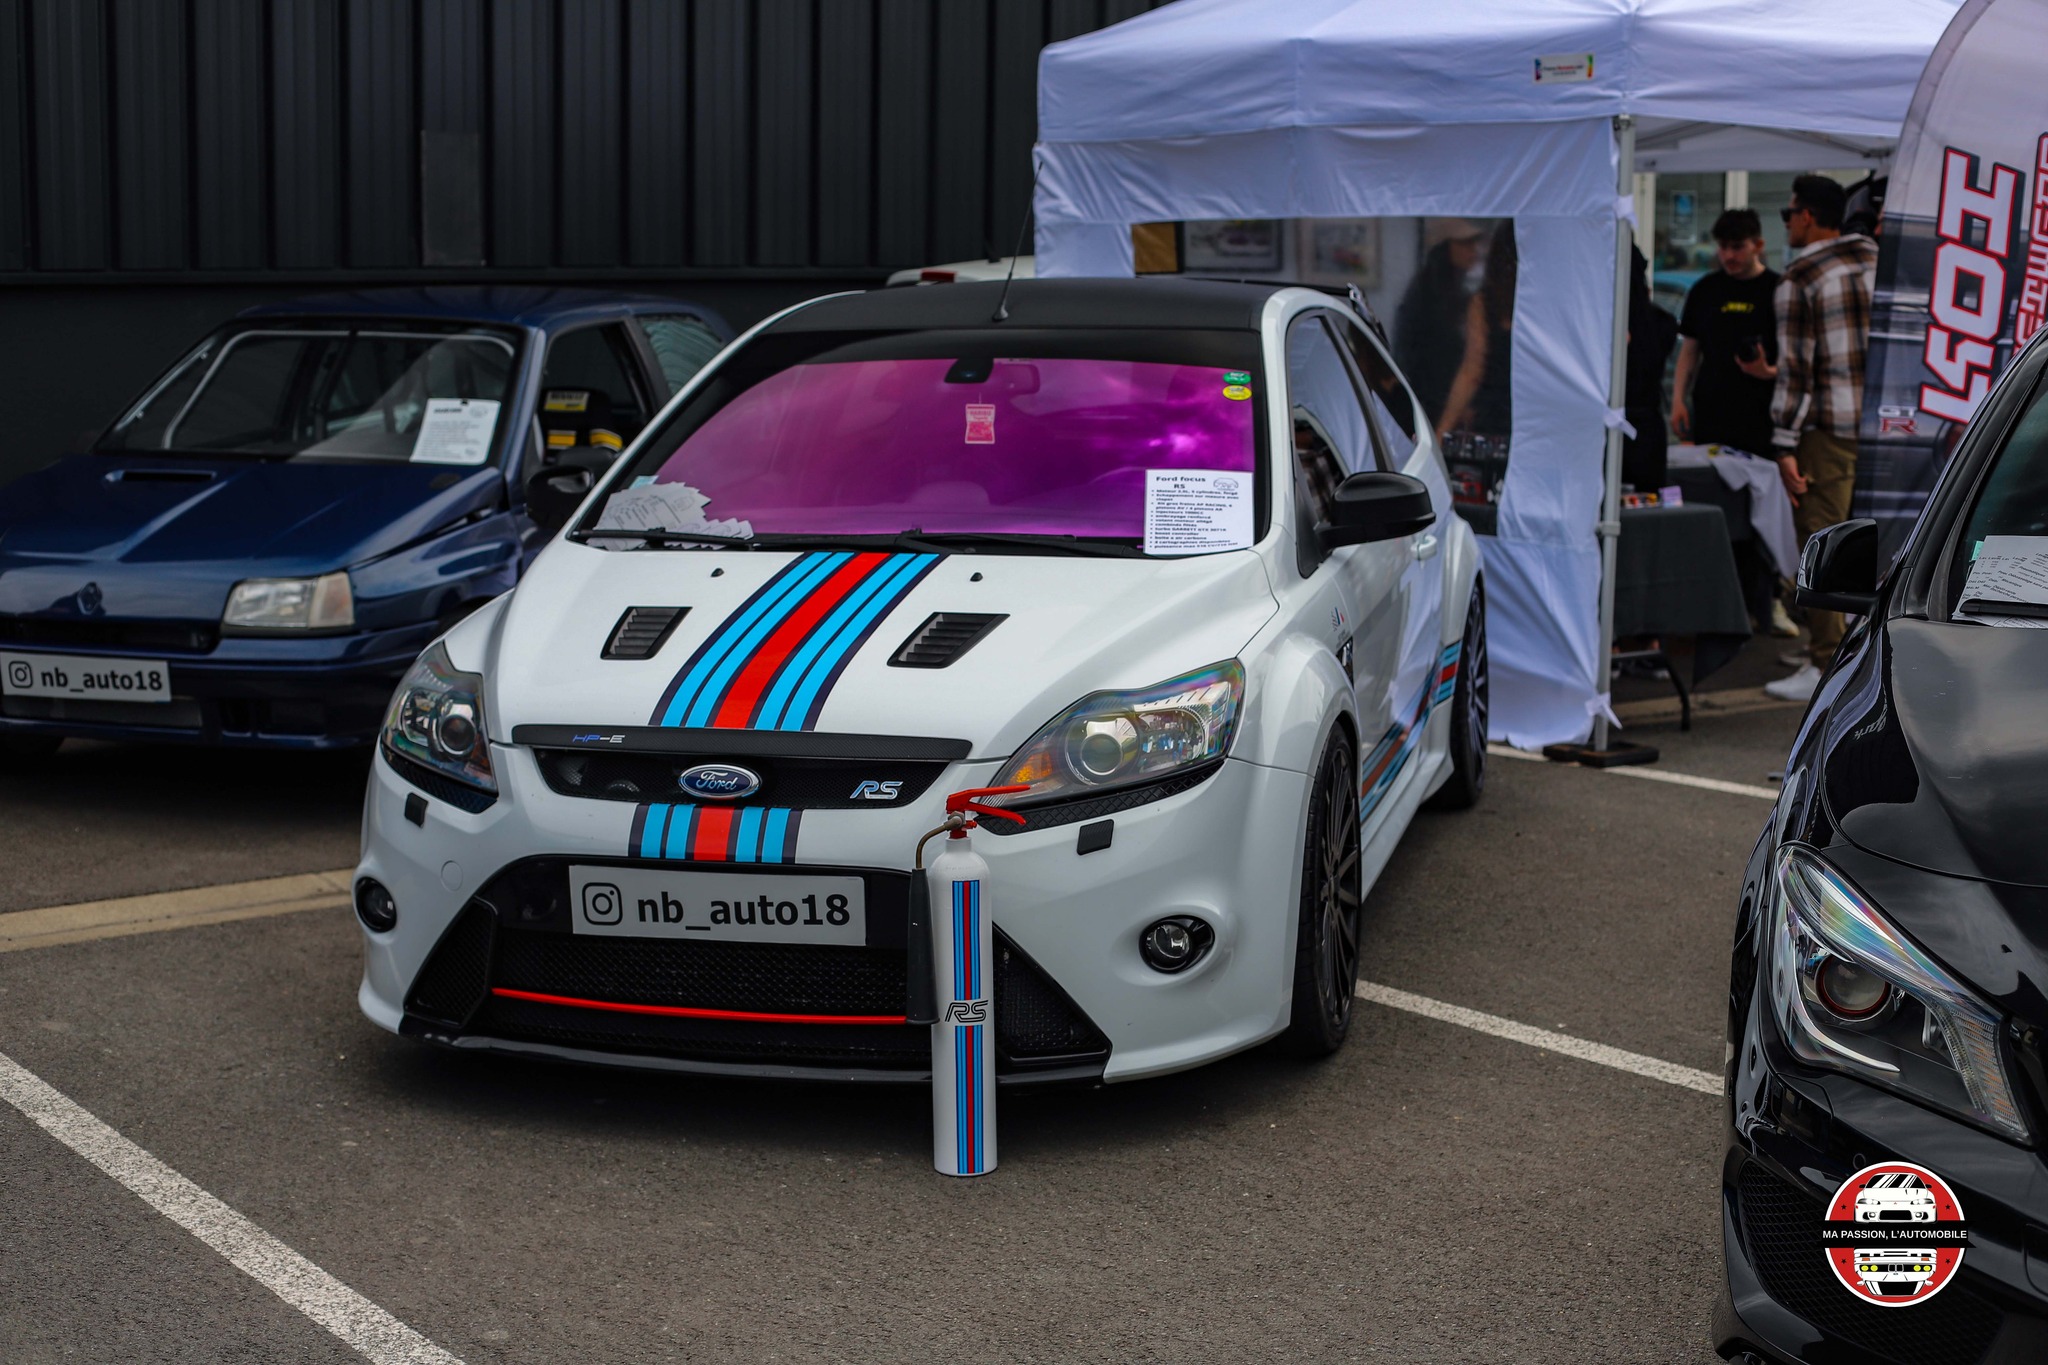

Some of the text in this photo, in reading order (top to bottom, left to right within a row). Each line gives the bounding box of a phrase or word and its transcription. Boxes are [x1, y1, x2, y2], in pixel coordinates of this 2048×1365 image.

[41, 667, 163, 692] nb_auto18
[695, 770, 739, 790] Ford
[849, 780, 903, 800] RS
[637, 891, 850, 931] nb_auto18
[945, 1000, 988, 1023] RS
